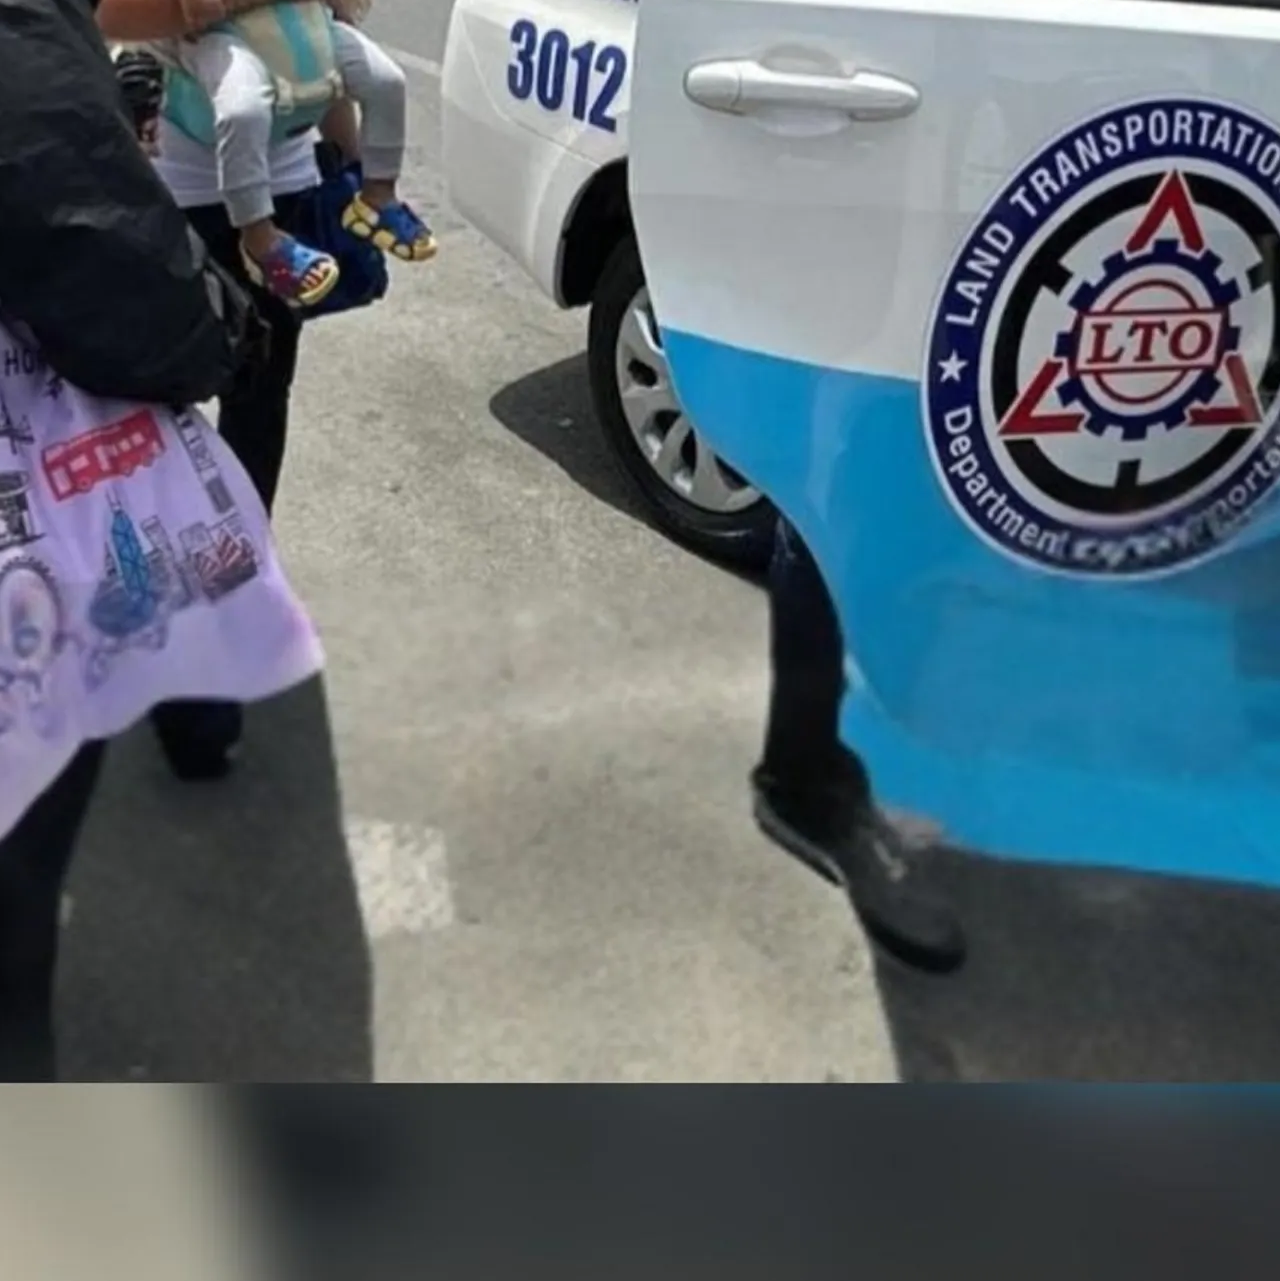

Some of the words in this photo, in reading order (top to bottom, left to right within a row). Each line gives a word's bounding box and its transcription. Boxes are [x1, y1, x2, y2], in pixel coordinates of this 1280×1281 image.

[507, 18, 627, 133] 3012
[945, 220, 1015, 327] LAND
[1086, 319, 1213, 365] LTO
